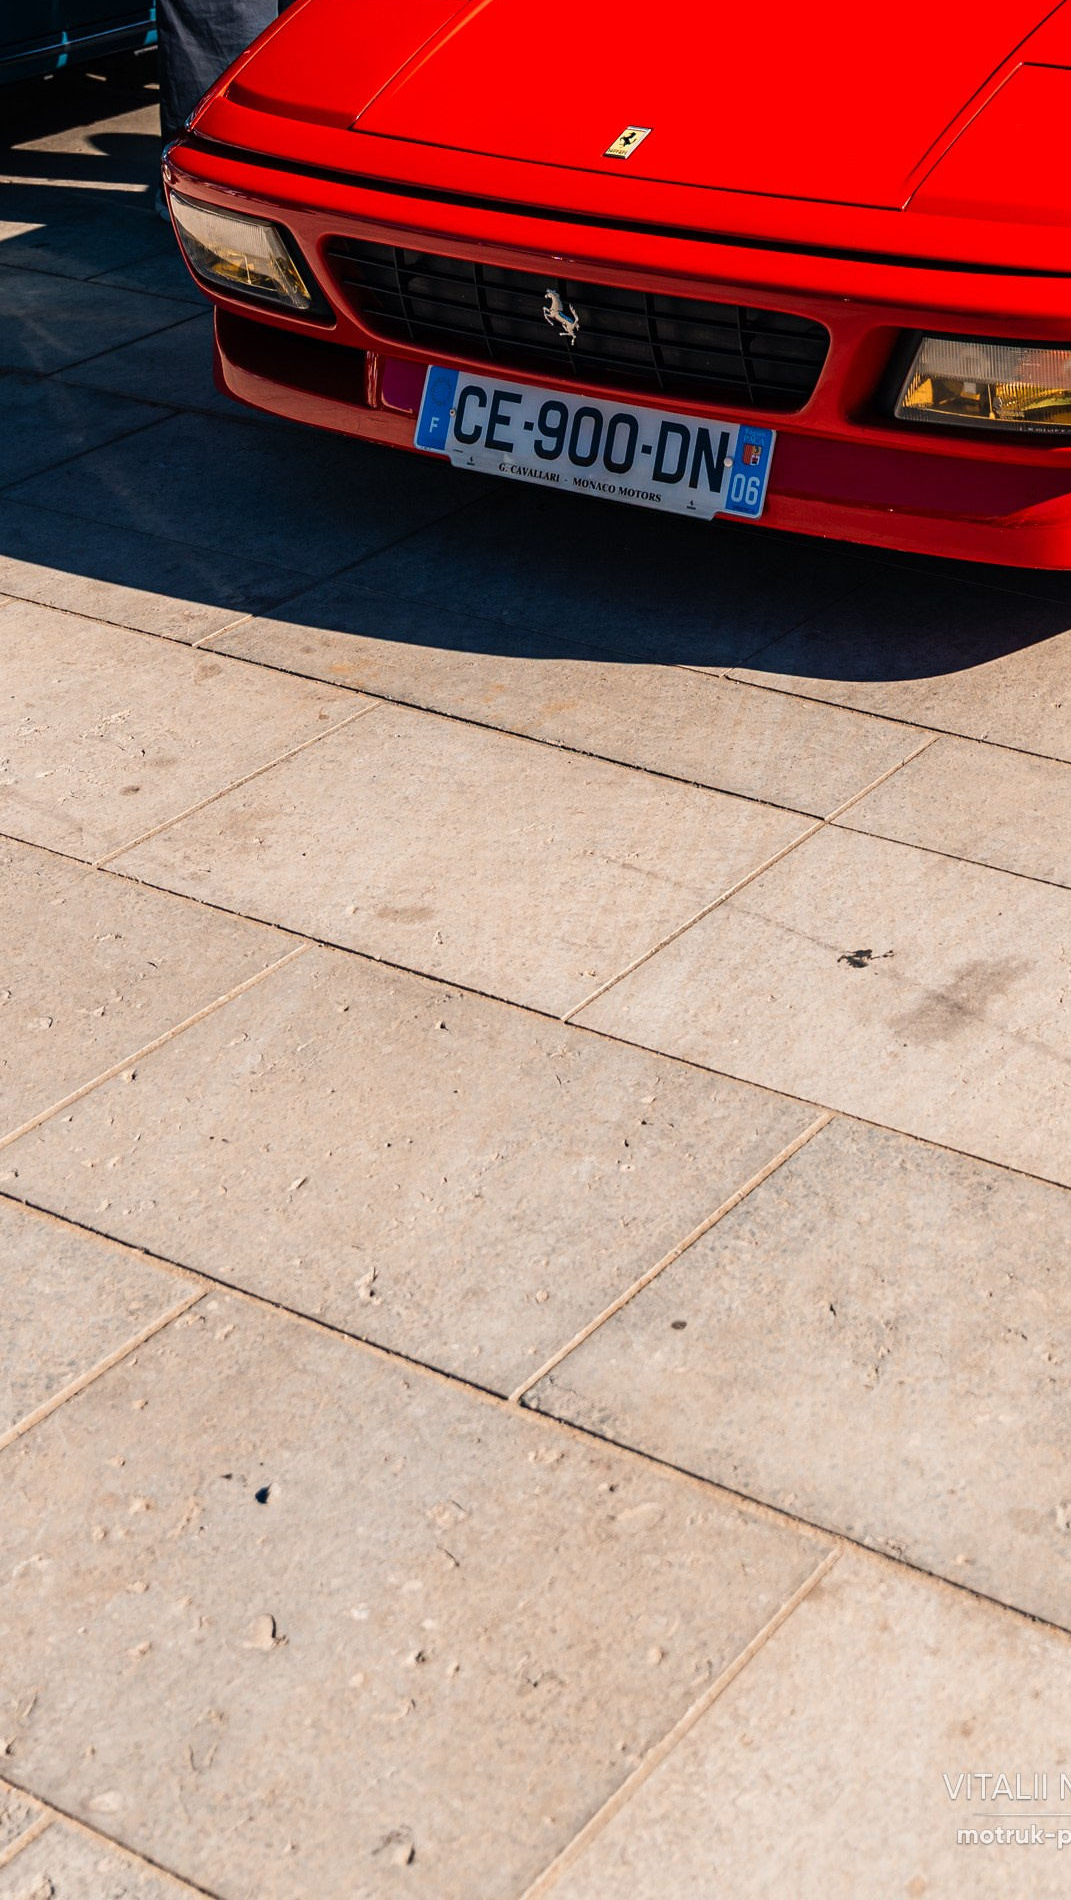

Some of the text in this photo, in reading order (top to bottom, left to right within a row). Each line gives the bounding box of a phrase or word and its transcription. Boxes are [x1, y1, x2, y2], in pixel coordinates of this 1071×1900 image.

[428, 416, 440, 433] F
[452, 385, 730, 494] CE-900-DN
[510, 465, 560, 483] CAVALLARI
[573, 477, 616, 494] MONACO
[618, 486, 662, 503] MOTORS
[730, 473, 761, 506] 06
